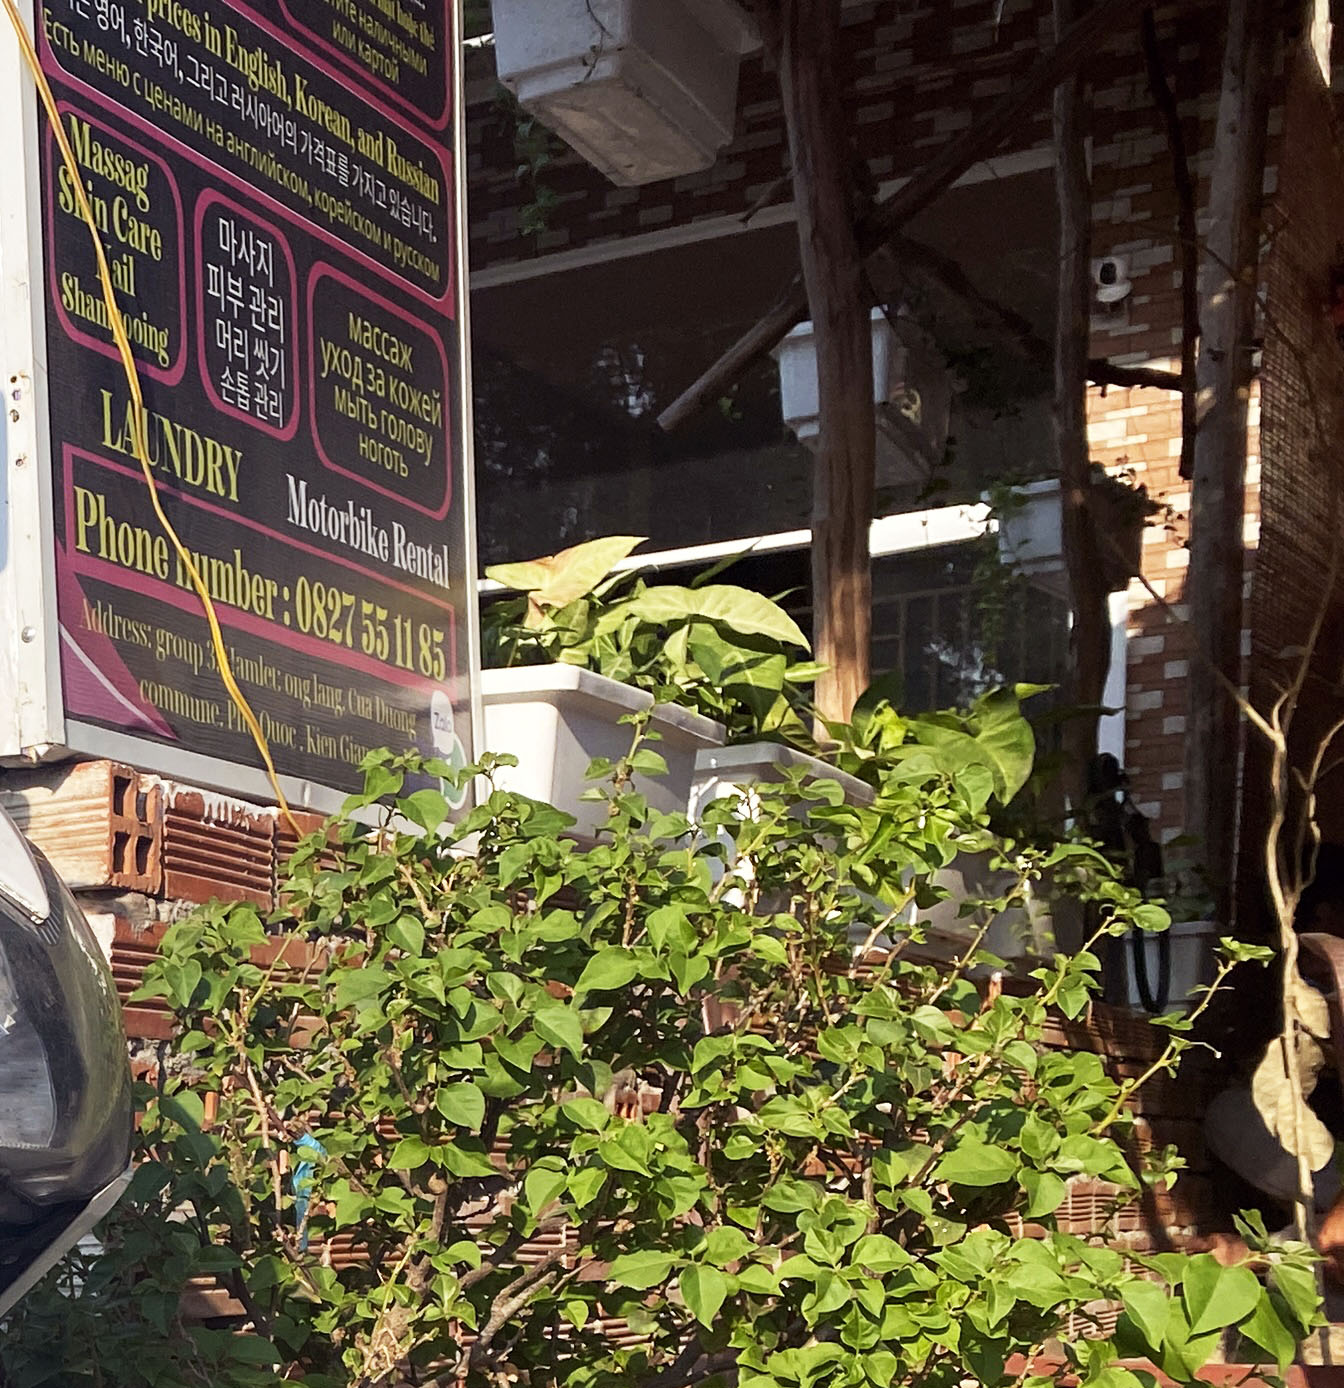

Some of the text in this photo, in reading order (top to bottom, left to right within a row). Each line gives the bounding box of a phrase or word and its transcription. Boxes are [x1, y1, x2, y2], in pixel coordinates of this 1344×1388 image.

[332, 19, 399, 84] или картой
[358, 7, 427, 77] наличными
[44, 8, 80, 56] Есть
[83, 40, 130, 87] меню
[133, 72, 141, 95] с
[144, 76, 203, 135] ценами
[206, 121, 224, 147] на
[227, 131, 312, 208] английском,
[314, 187, 381, 246] корейском
[383, 232, 393, 249] и
[393, 237, 440, 282] русском
[133, 17, 184, 84] 한국어,
[186, 54, 229, 107] 그리고
[231, 83, 297, 155] 러시아어의
[300, 130, 350, 187] 가격표를
[352, 164, 387, 208] 가지고
[389, 188, 437, 244] 있습니다.
[204, 11, 221, 57] in
[224, 24, 292, 112] English,
[295, 73, 356, 147] Korean,
[357, 127, 383, 167] and
[386, 136, 439, 205] Russian
[68, 113, 150, 212] Massag
[113, 195, 162, 261] Care
[219, 217, 274, 287] 마사지
[96, 243, 136, 297] ail
[207, 263, 284, 344] 피부 관리
[62, 272, 169, 368] Shamooing
[216, 318, 285, 390] 머리 씻기
[349, 312, 413, 373] массаж
[220, 366, 283, 428] 손톱 관리
[320, 337, 442, 429] уход за кожей
[100, 388, 243, 502] LAUNDRY
[334, 385, 433, 467] мыть голову
[359, 433, 409, 478] ноготь
[286, 473, 450, 590] Motorbike Rental
[73, 485, 169, 580] Phone
[176, 547, 278, 620] number
[295, 576, 356, 648] 0827
[361, 600, 389, 661] 55
[394, 613, 414, 672] 11
[418, 623, 446, 682] 85
[79, 598, 151, 648] Address:
[156, 628, 203, 676] group
[285, 672, 311, 710] ong
[348, 688, 372, 720] Cua
[375, 696, 416, 741] Duong
[260, 711, 296, 749] Quoc
[306, 725, 337, 759] Kien
